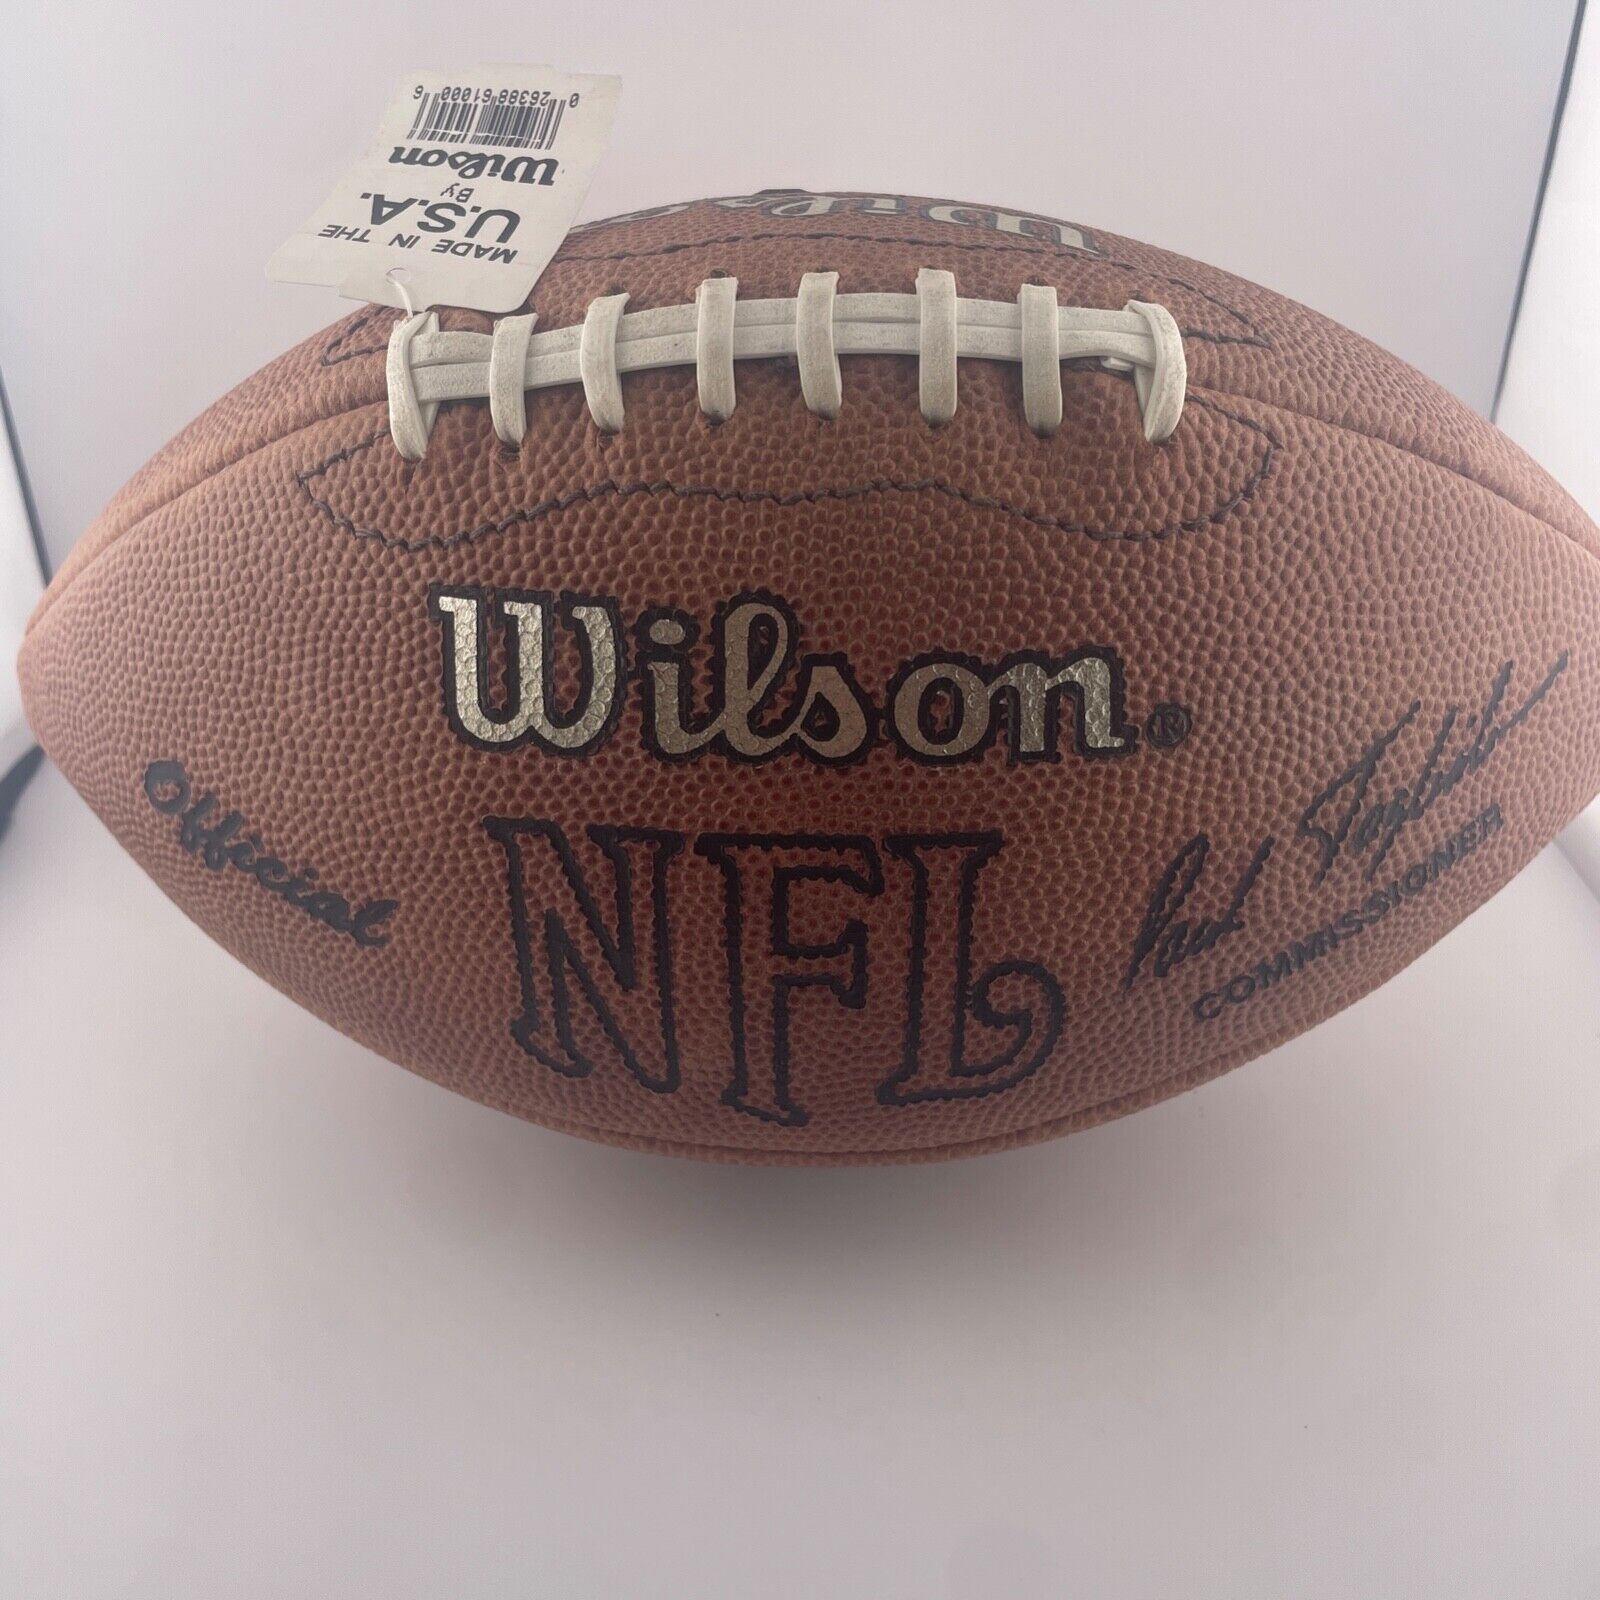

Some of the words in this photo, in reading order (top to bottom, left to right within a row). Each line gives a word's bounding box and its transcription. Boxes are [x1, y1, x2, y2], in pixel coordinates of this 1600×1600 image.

[413, 85, 425, 100] 6
[440, 86, 493, 105] 61000
[498, 89, 551, 108] 26388
[568, 92, 580, 108] 0
[388, 146, 560, 186] Wilson
[360, 192, 521, 243] U.S.A.
[318, 224, 371, 243] THE
[388, 233, 421, 249] IN
[431, 239, 519, 264] MADE
[429, 583, 1140, 768] Wilson
[143, 760, 399, 946] Official
[1193, 802, 1505, 1021] COMMISSIONER
[483, 816, 1068, 1128] NFL
